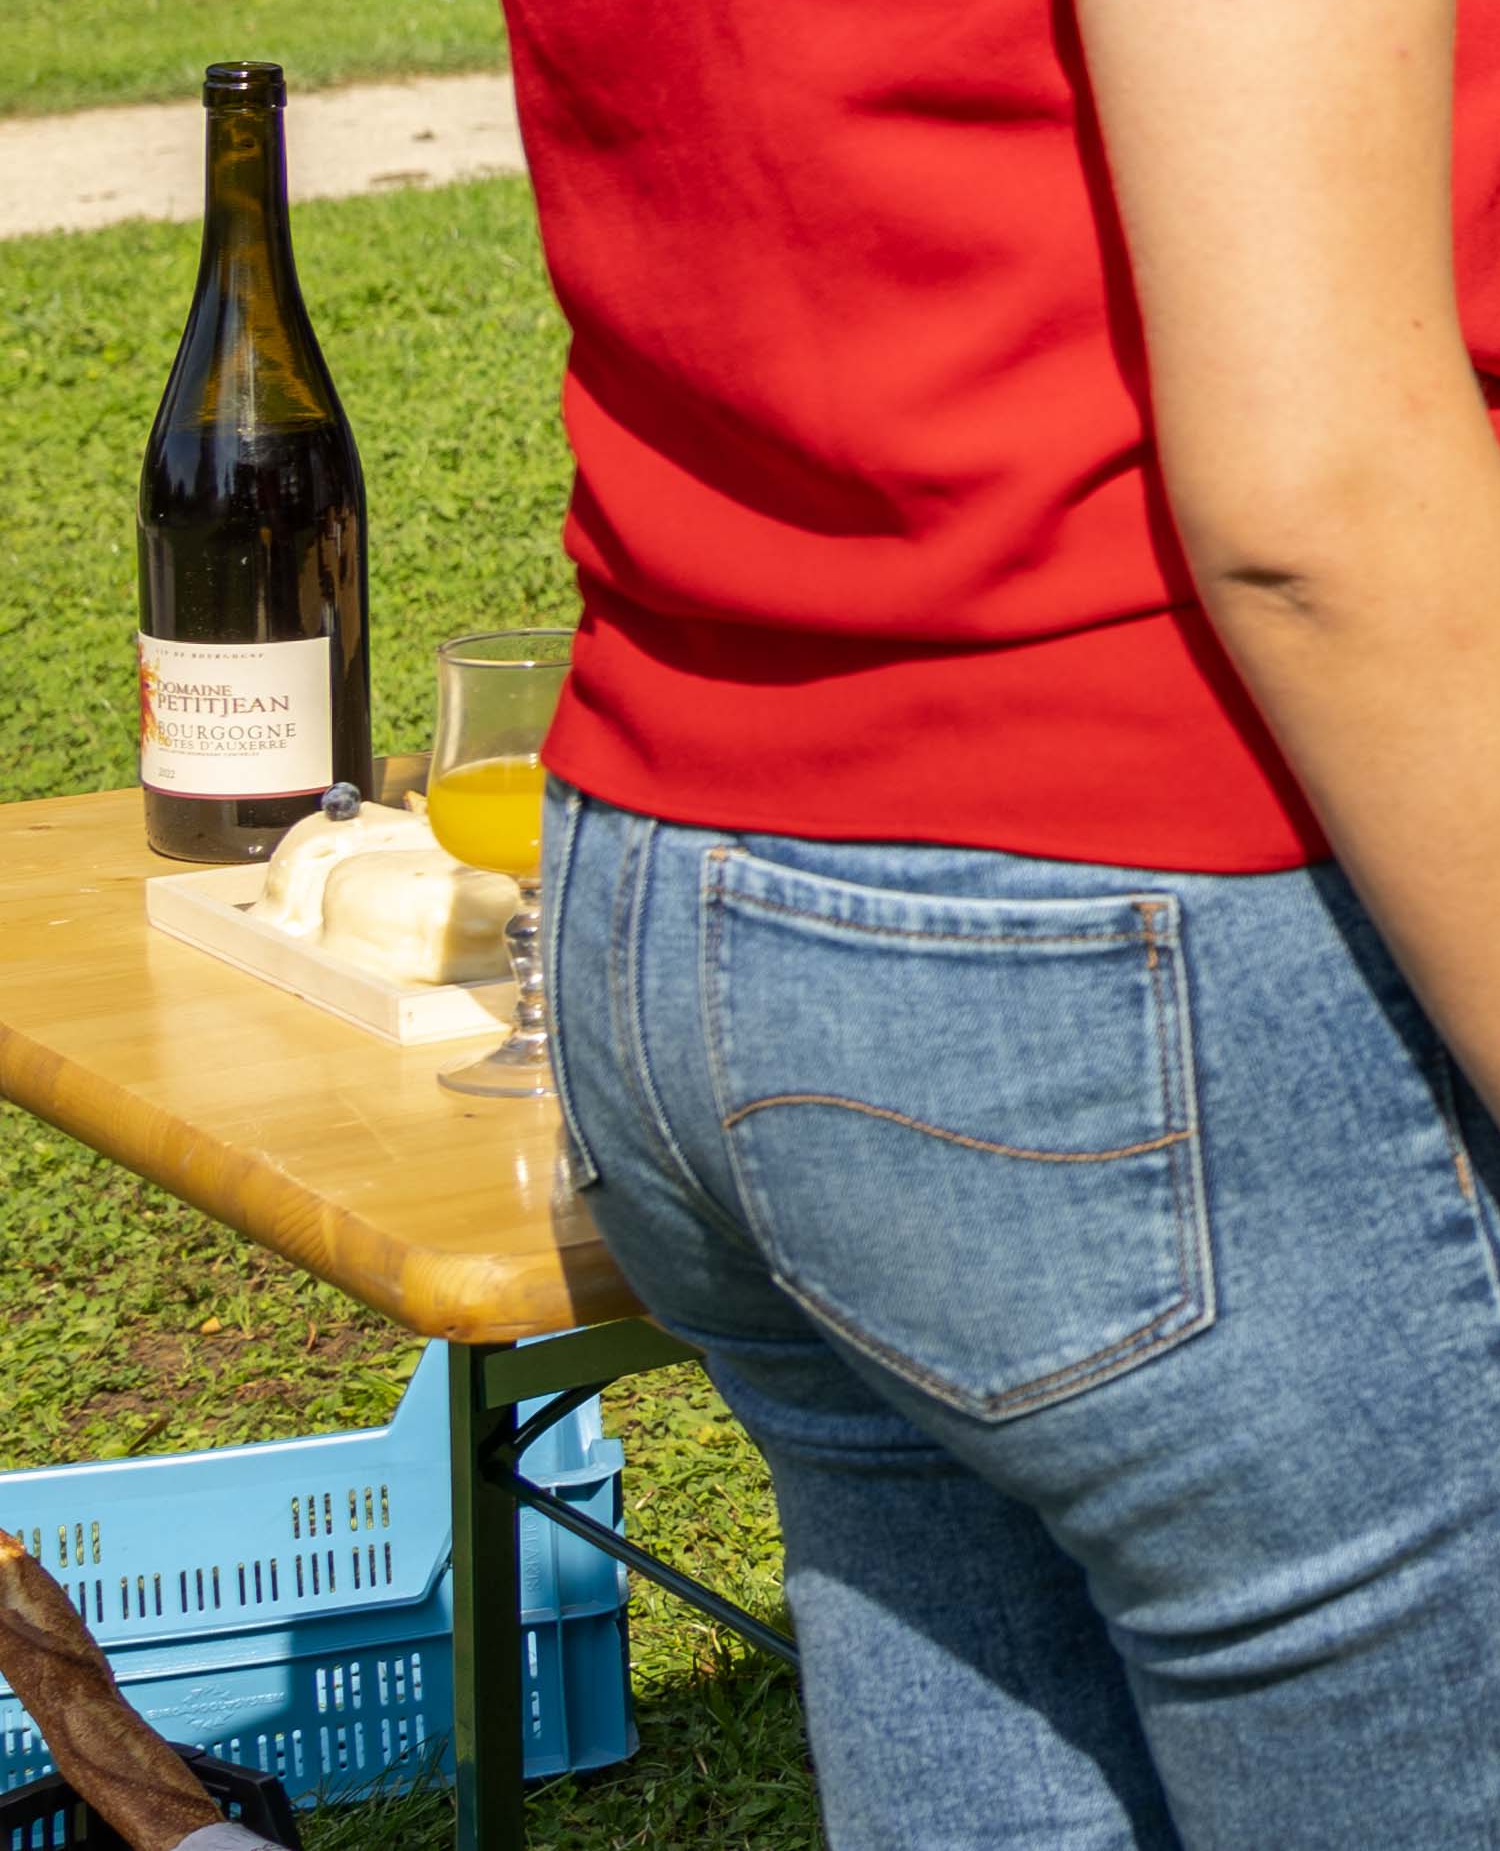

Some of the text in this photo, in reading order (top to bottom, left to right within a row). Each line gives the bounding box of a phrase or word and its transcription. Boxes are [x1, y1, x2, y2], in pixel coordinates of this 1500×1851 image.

[157, 680, 232, 696] DOMAINE
[158, 693, 289, 717] PETITJEAN
[158, 721, 296, 740] BOURGOGNE
[200, 739, 288, 751] D'AUXERRE
